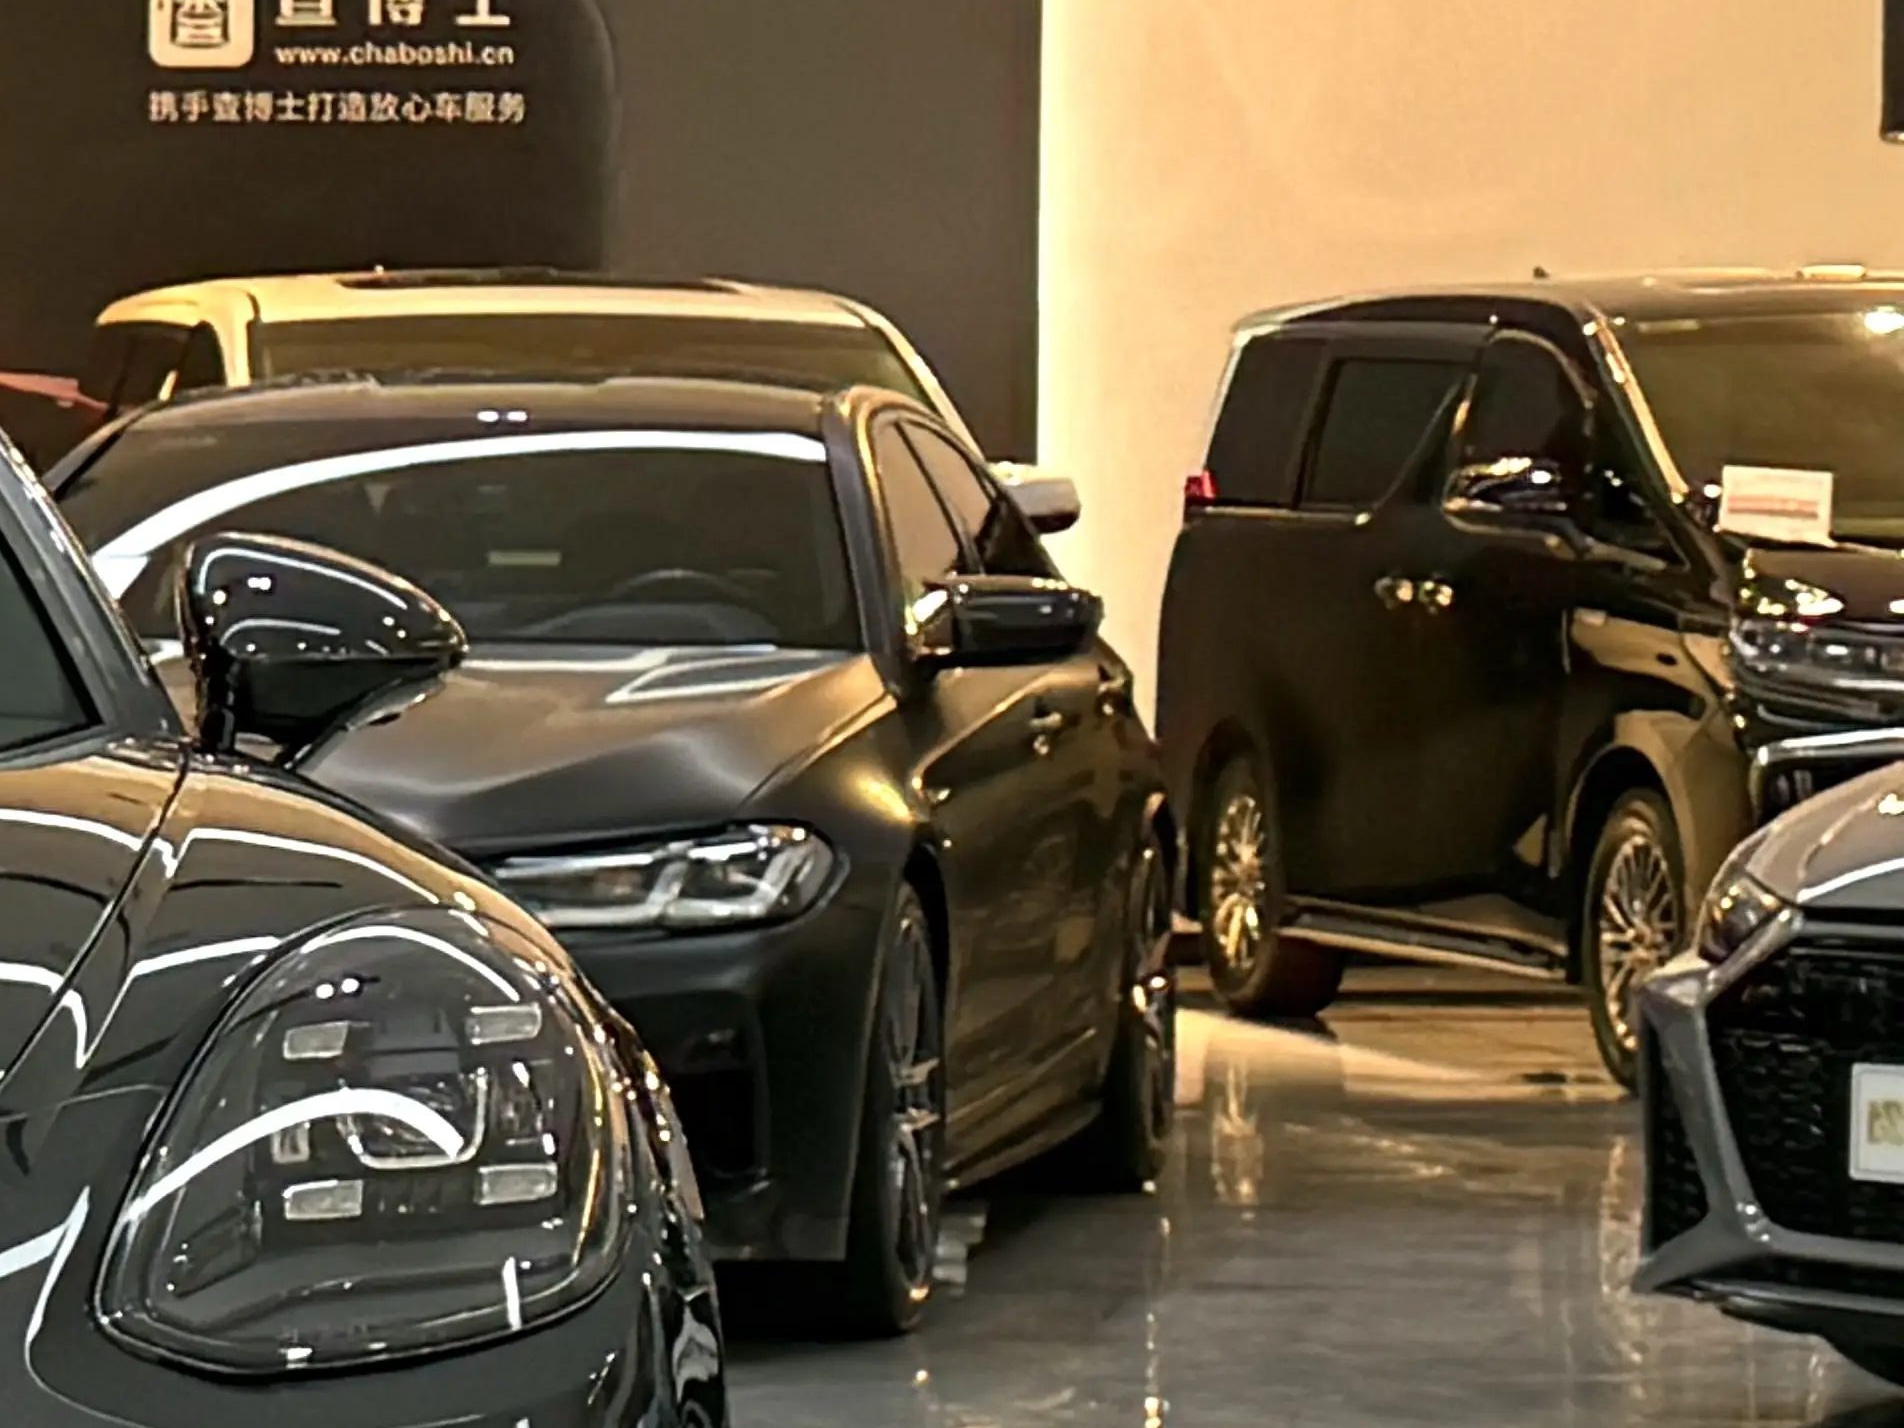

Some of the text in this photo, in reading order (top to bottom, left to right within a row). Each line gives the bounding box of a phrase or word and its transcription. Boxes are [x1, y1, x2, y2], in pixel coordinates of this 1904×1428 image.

[273, 41, 515, 66] www.chaboshi.cn
[148, 90, 526, 124] 携手查博士打造放心车服务
